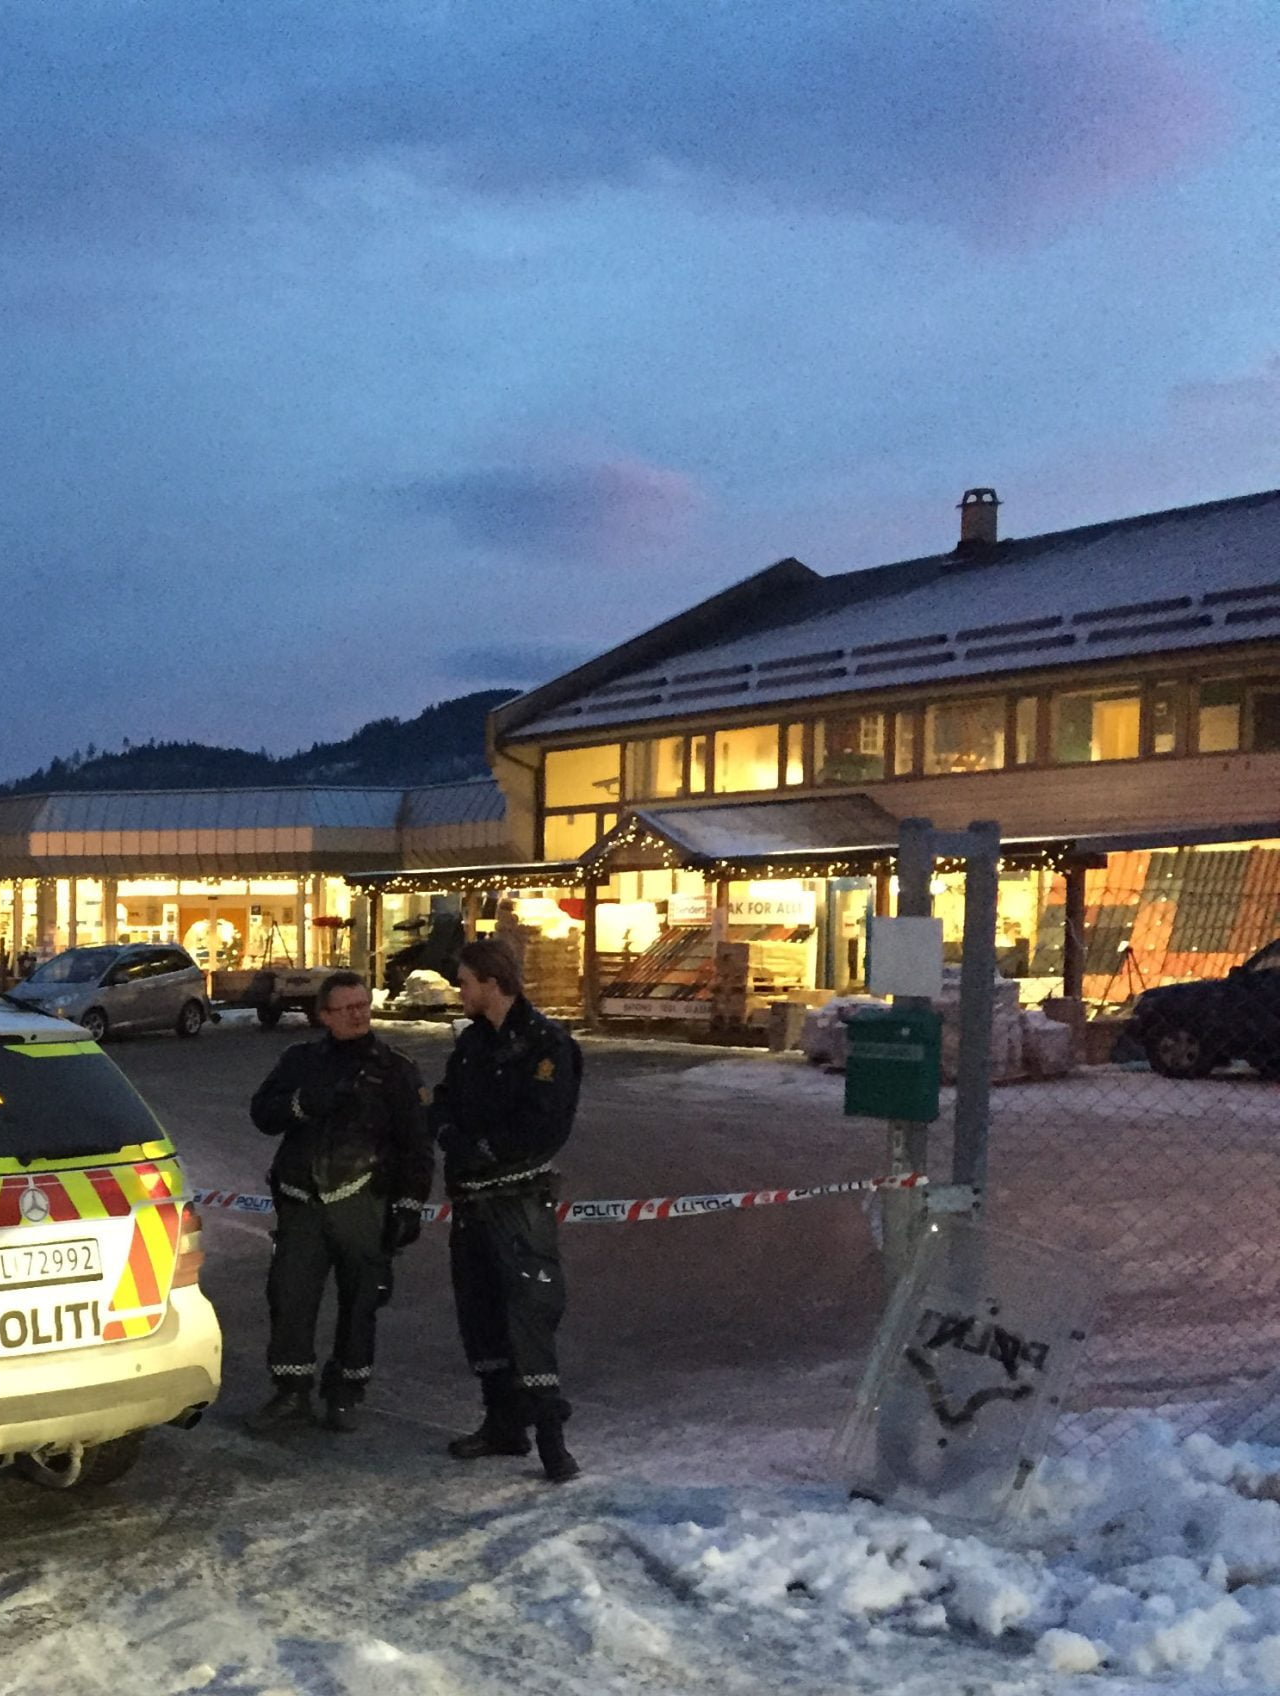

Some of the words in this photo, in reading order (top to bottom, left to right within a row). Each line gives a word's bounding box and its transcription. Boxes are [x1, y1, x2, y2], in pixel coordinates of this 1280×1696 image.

[748, 902, 771, 915] FOR
[573, 1203, 626, 1217] POLITI
[23, 1246, 94, 1276] 72992
